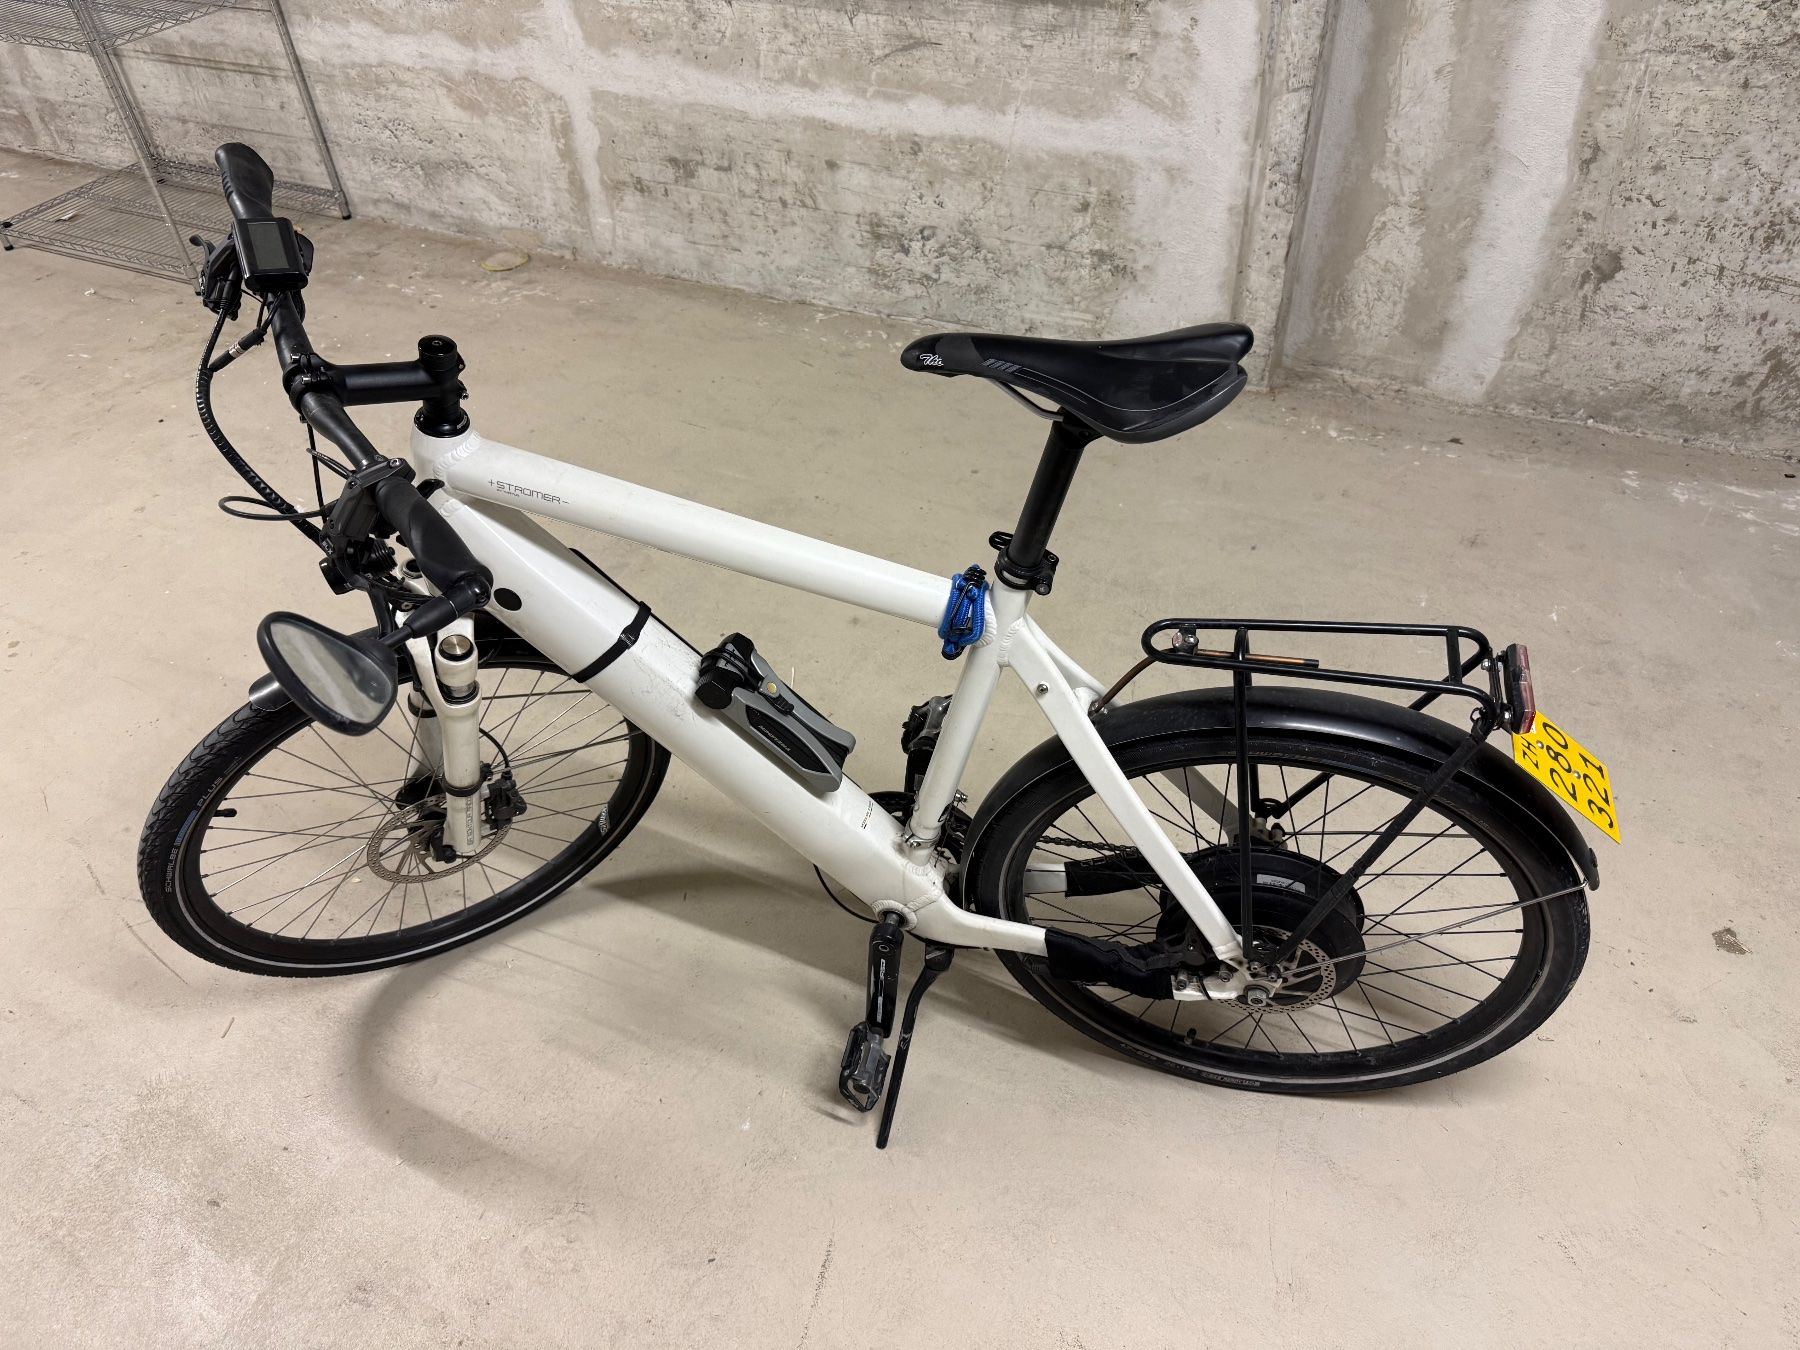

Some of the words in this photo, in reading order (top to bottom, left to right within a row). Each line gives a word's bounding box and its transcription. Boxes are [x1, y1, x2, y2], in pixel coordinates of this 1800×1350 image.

[1520, 735, 1540, 770] ZH
[1542, 721, 1578, 803] 280
[1578, 751, 1614, 829] 321
[165, 847, 179, 894] SCHWALBE
[197, 776, 223, 807] PLUS
